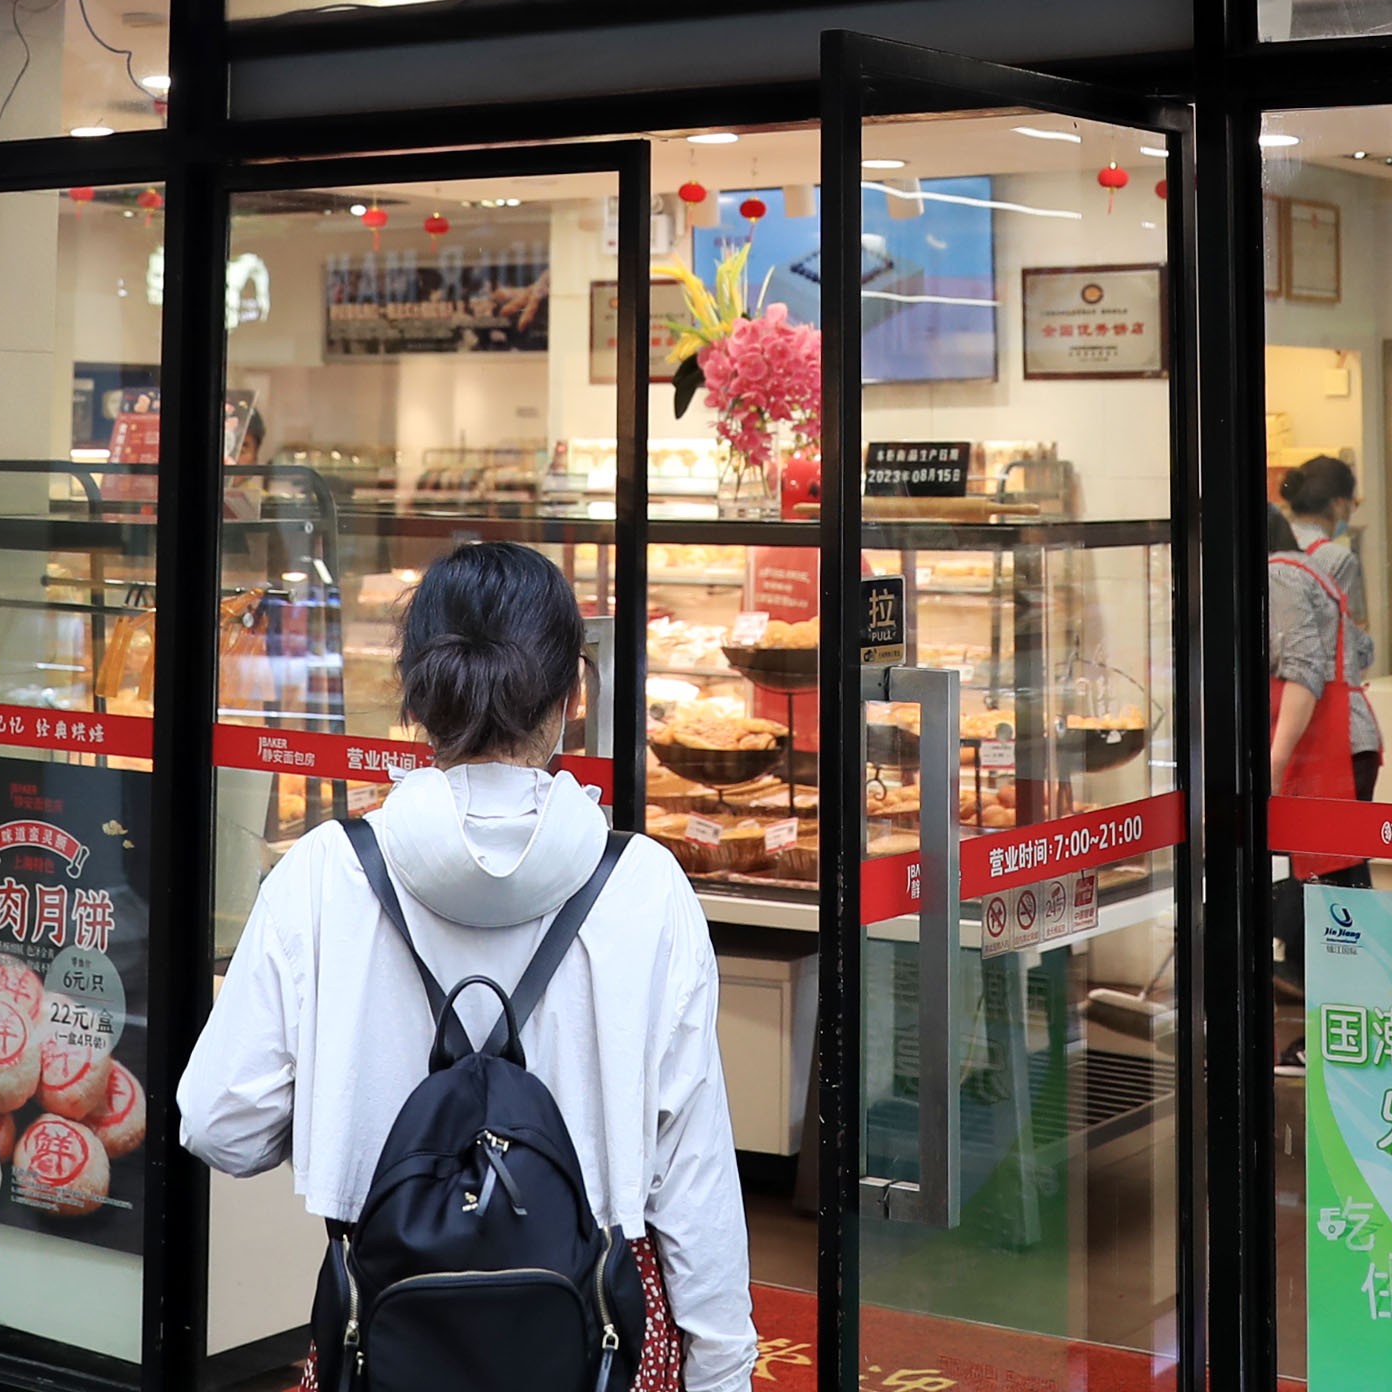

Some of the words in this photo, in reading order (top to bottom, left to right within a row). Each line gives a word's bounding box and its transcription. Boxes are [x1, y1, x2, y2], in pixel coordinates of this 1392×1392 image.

[868, 587, 896, 629] 拉
[261, 749, 316, 768] 静安面包房
